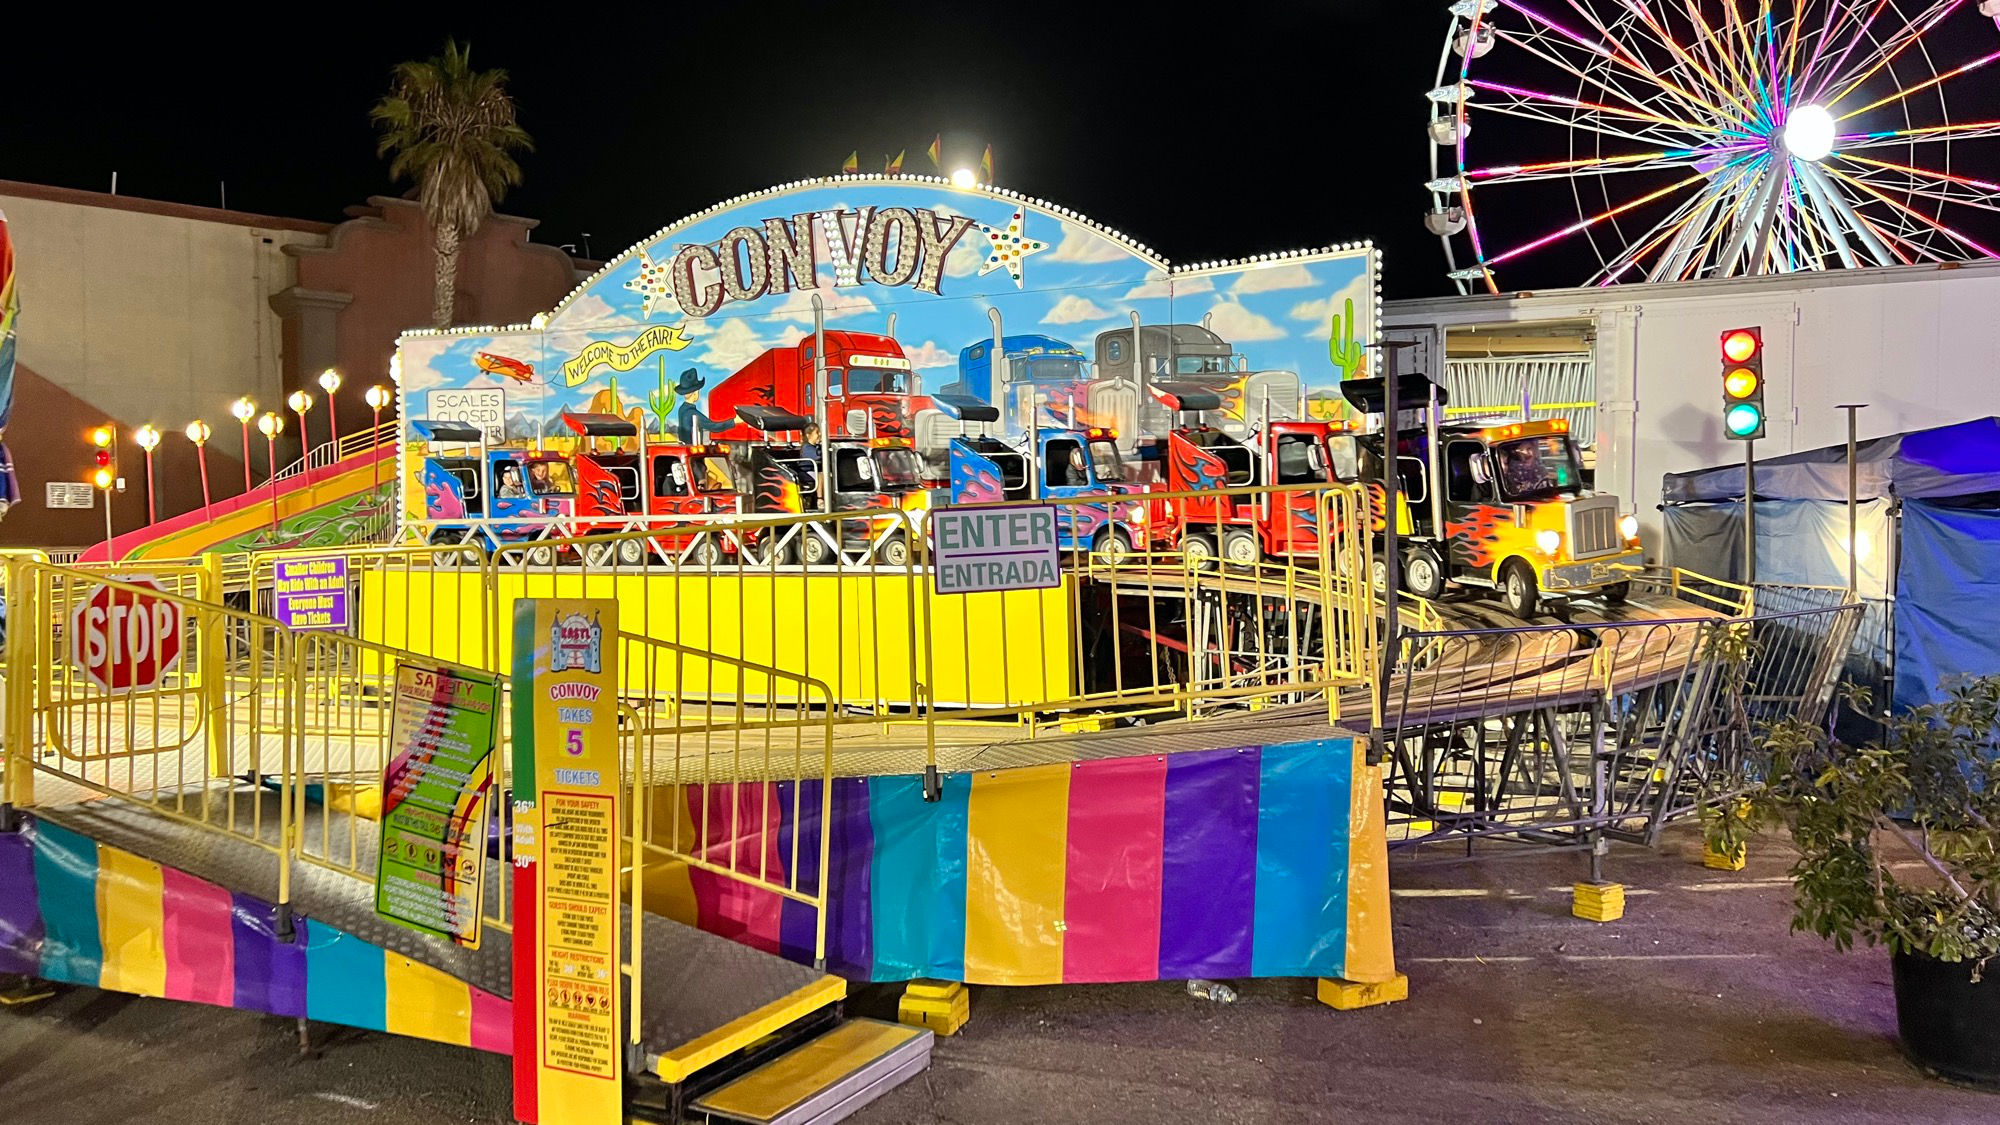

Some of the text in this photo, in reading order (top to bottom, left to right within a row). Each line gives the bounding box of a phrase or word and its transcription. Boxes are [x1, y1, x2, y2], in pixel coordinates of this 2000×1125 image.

[674, 206, 975, 317] CONVOY
[568, 329, 672, 379] WELCOME TO THE FAIR!
[436, 394, 500, 408] SCALES
[939, 512, 1053, 549] ENTER
[284, 561, 336, 577] Smaller Children
[940, 560, 1055, 588] ENTRADA
[290, 578, 304, 592] Ride
[304, 577, 319, 591] With
[328, 575, 345, 589] Adult
[289, 595, 334, 611] Everyone Must
[291, 611, 331, 625] Have Tickets
[88, 602, 174, 668] STOP
[415, 672, 475, 696] SAFETY
[550, 682, 601, 701] CONVOY
[558, 707, 592, 724] TAKES
[567, 728, 583, 756] 5
[554, 769, 600, 786] TICKETS
